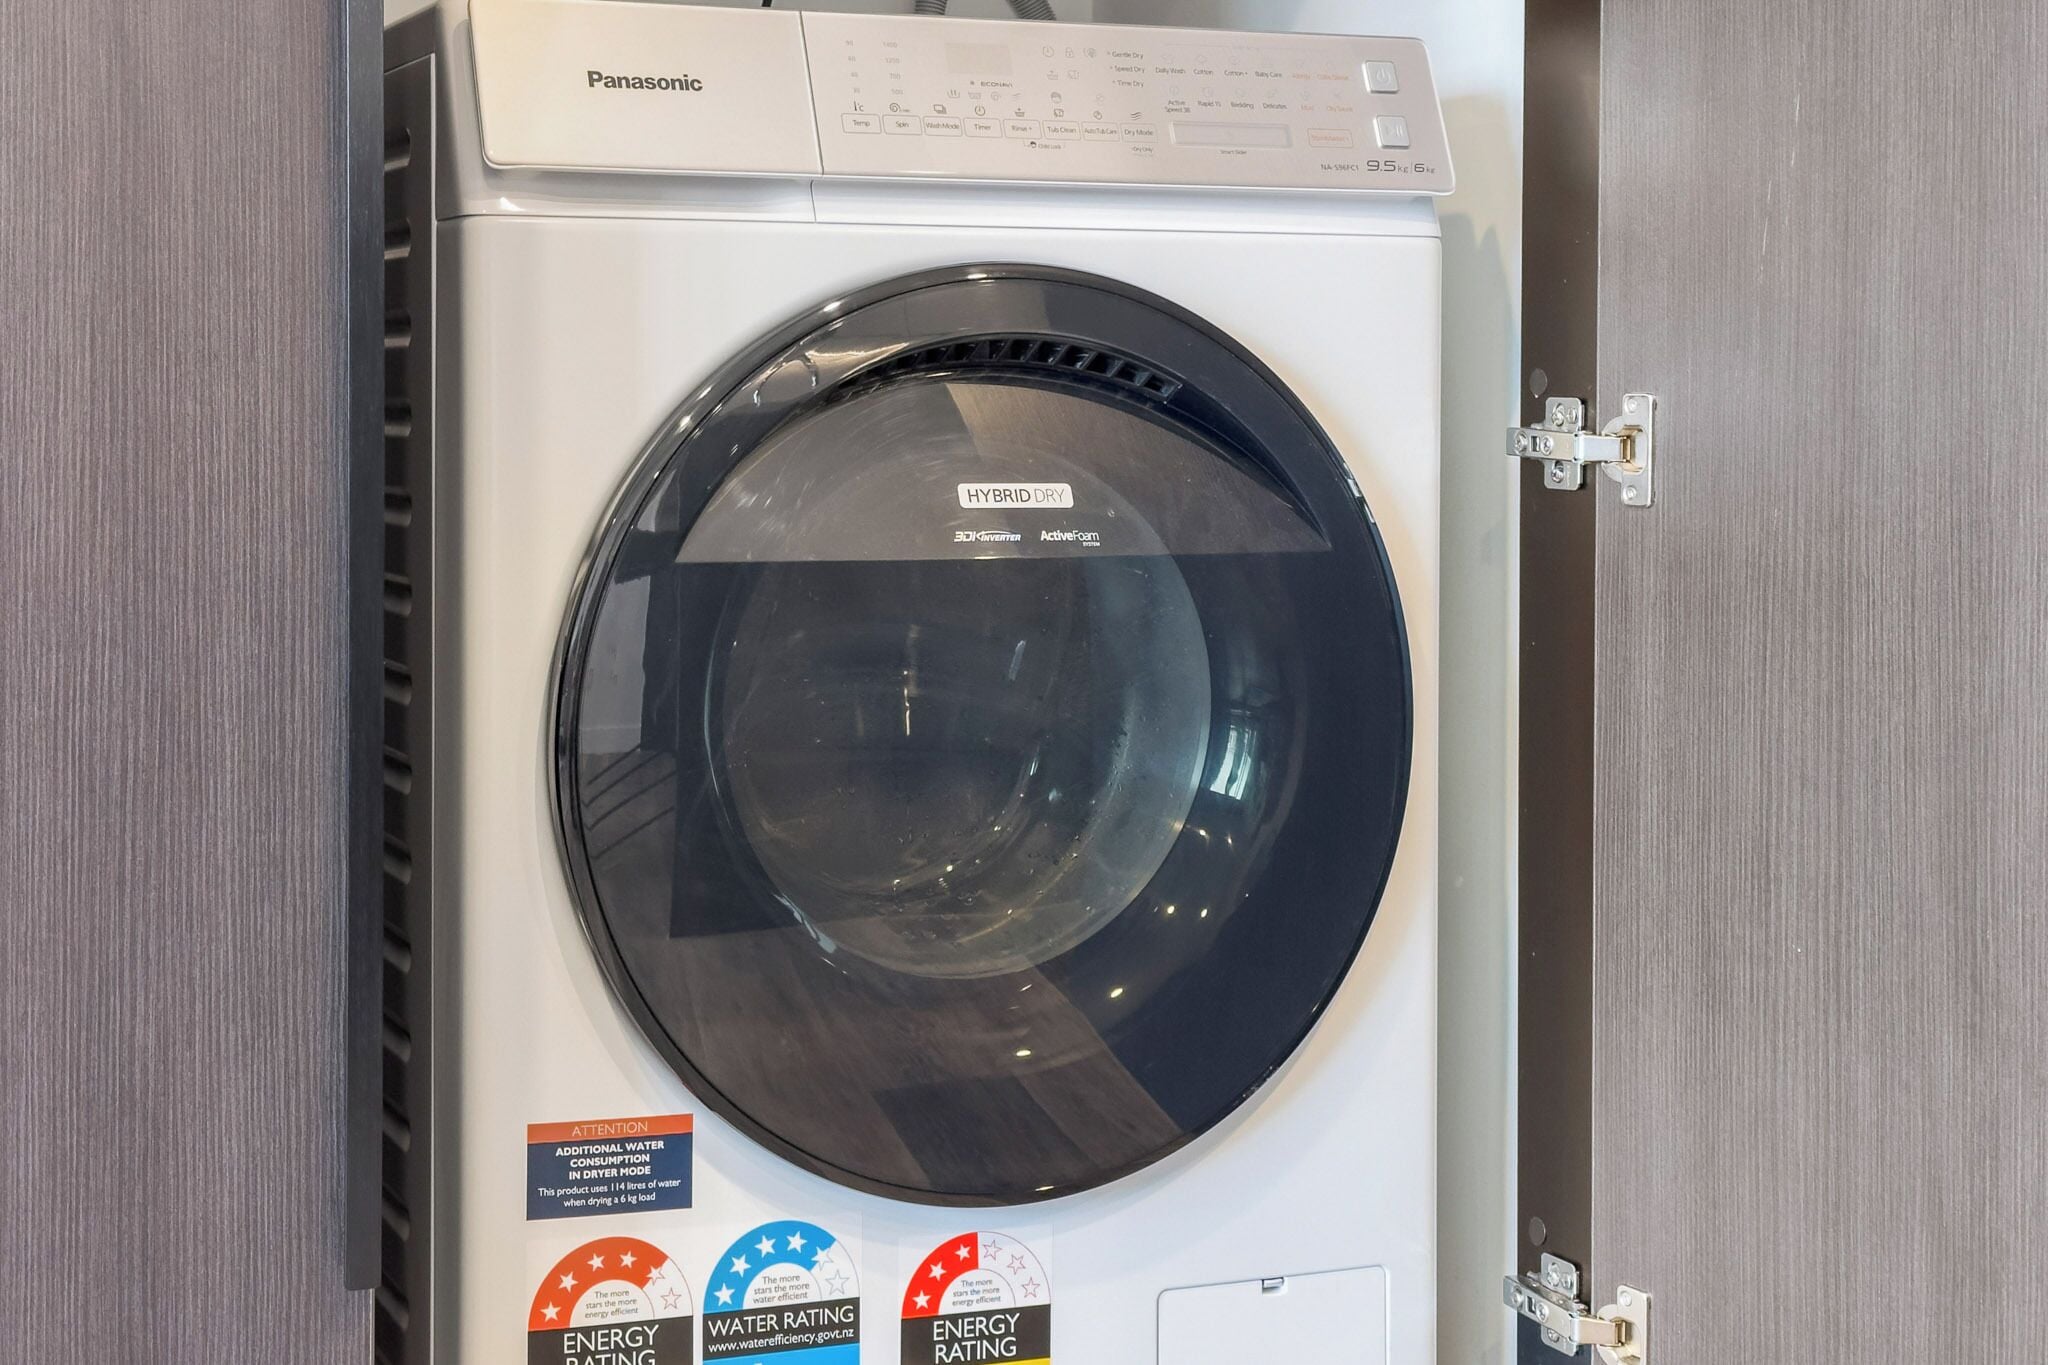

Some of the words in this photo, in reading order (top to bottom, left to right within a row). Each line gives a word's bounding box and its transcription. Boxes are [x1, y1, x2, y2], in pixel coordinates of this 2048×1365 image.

[1115, 65, 1132, 73] Speed
[1134, 66, 1144, 74] Dry
[586, 70, 703, 91] Panasonic
[1133, 80, 1144, 88] Dry
[967, 488, 1031, 503] HYBRID
[1034, 488, 1065, 503] DRY
[980, 532, 1022, 542] INVERTER
[1040, 530, 1100, 542] ActiveFoam
[572, 1121, 648, 1137] ATTENTION
[555, 1144, 623, 1157] ADDITIONAL
[625, 1140, 665, 1151] WATER
[570, 1153, 650, 1168] CONSUMPTION
[569, 1170, 581, 1180] IN
[583, 1168, 618, 1179] DRYER
[620, 1165, 651, 1177] MODE
[538, 1187, 555, 1197] This
[556, 1184, 589, 1197] product
[590, 1184, 608, 1193] uses
[611, 1182, 625, 1192] 114
[627, 1181, 646, 1190] litres
[648, 1179, 657, 1188] of
[658, 1178, 681, 1188] water
[563, 1197, 585, 1208] when
[587, 1196, 612, 1208] drying
[614, 1196, 619, 1204] a
[620, 1194, 626, 1203] 6
[628, 1194, 637, 1205] kg
[639, 1191, 656, 1201] load
[763, 1276, 777, 1285] The
[779, 1274, 800, 1282] more
[595, 1291, 608, 1299] The
[610, 1289, 630, 1297] more
[754, 1286, 772, 1295] stars
[774, 1284, 787, 1293] the
[789, 1283, 810, 1291] more
[970, 1288, 981, 1296] the
[605, 1300, 617, 1308] the
[618, 1299, 637, 1307] more
[753, 1295, 776, 1304] water
[777, 1291, 808, 1302] efficient
[952, 1298, 974, 1307] energy
[975, 1294, 1001, 1304] efficient
[585, 1310, 609, 1319] energy
[611, 1307, 638, 1316] efficient
[708, 1314, 779, 1337] WATER
[784, 1306, 854, 1330] RATING
[933, 1313, 1020, 1341] ENERGY
[563, 1324, 659, 1354] ENERGY
[708, 1328, 854, 1353] www.waterefficiency.govt.nz
[935, 1337, 1017, 1365] RATING
